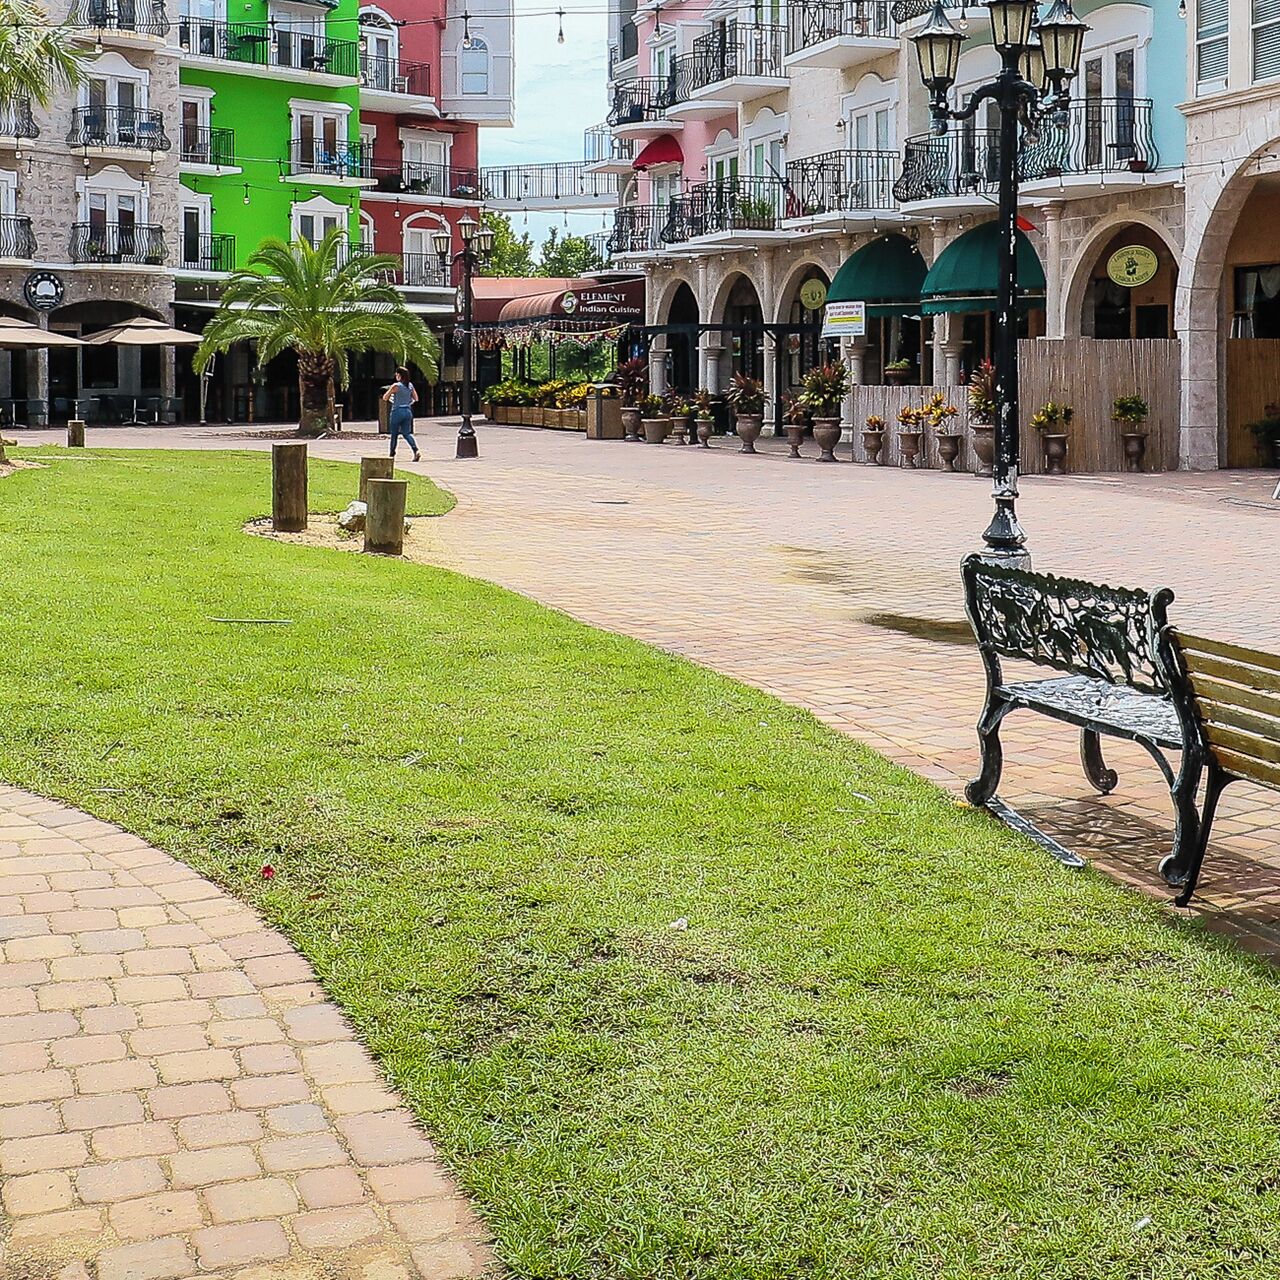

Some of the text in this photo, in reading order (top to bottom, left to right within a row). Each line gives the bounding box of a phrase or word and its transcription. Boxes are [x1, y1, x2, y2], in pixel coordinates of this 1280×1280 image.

[580, 292, 626, 302] ELEMENT
[580, 305, 641, 314] Indian Cuisine
